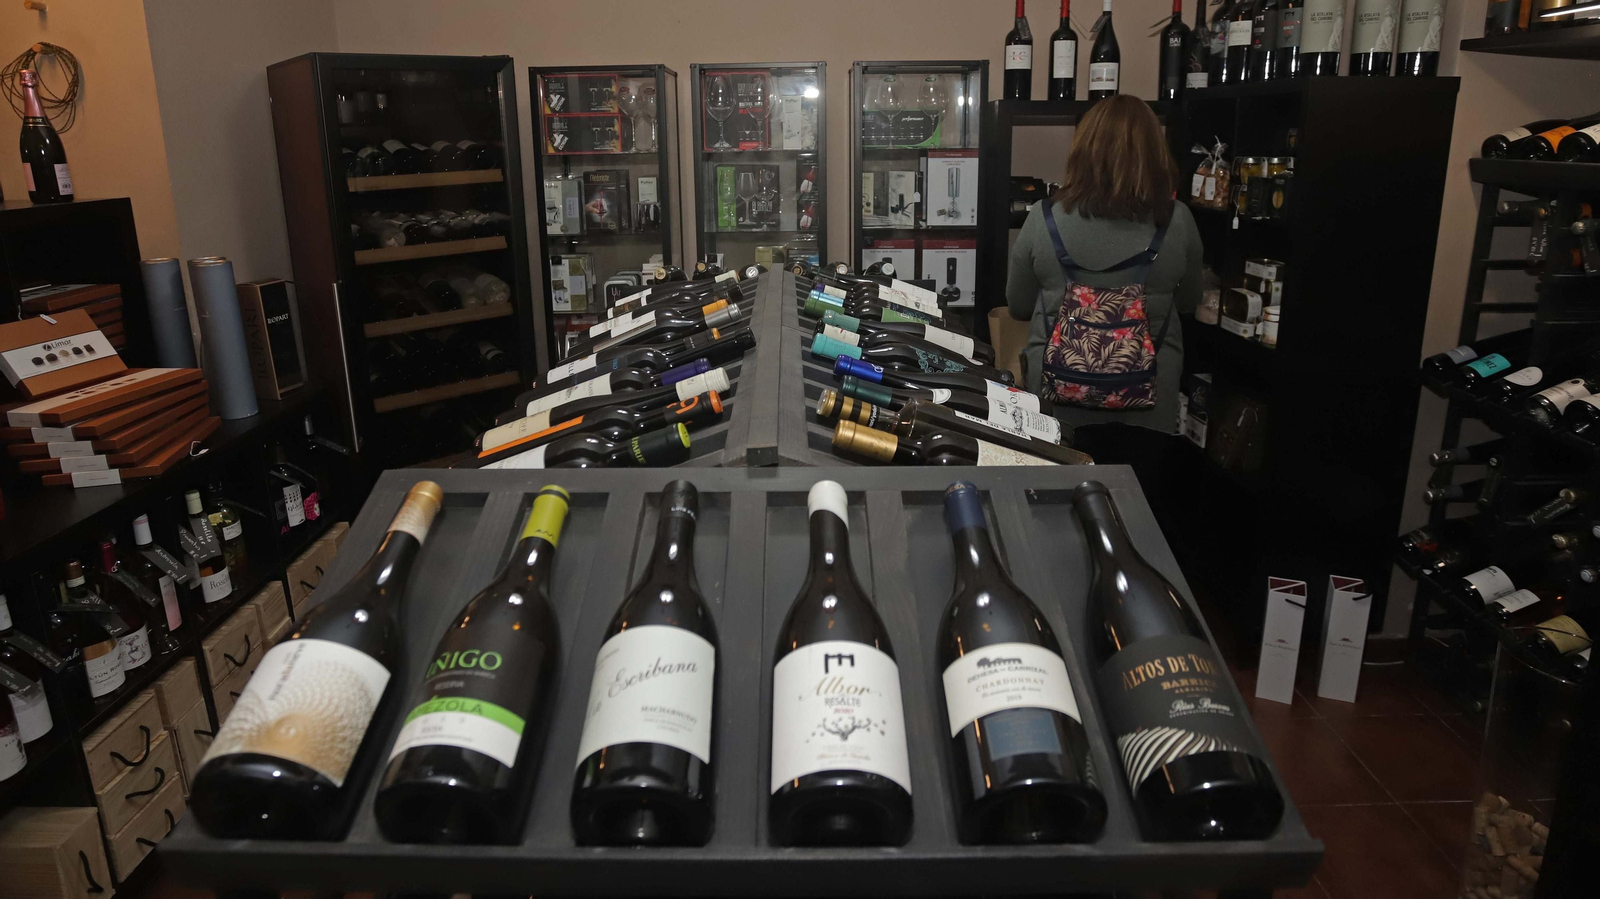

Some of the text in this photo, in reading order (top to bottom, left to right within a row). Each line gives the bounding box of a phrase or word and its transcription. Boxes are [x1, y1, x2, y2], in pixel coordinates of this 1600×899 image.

[51, 339, 72, 348] Limar
[967, 668, 1000, 684] DEHESA
[1122, 657, 1165, 691] ALTOS
[1166, 655, 1190, 674] DE
[975, 678, 1045, 693] CHARDONNAY
